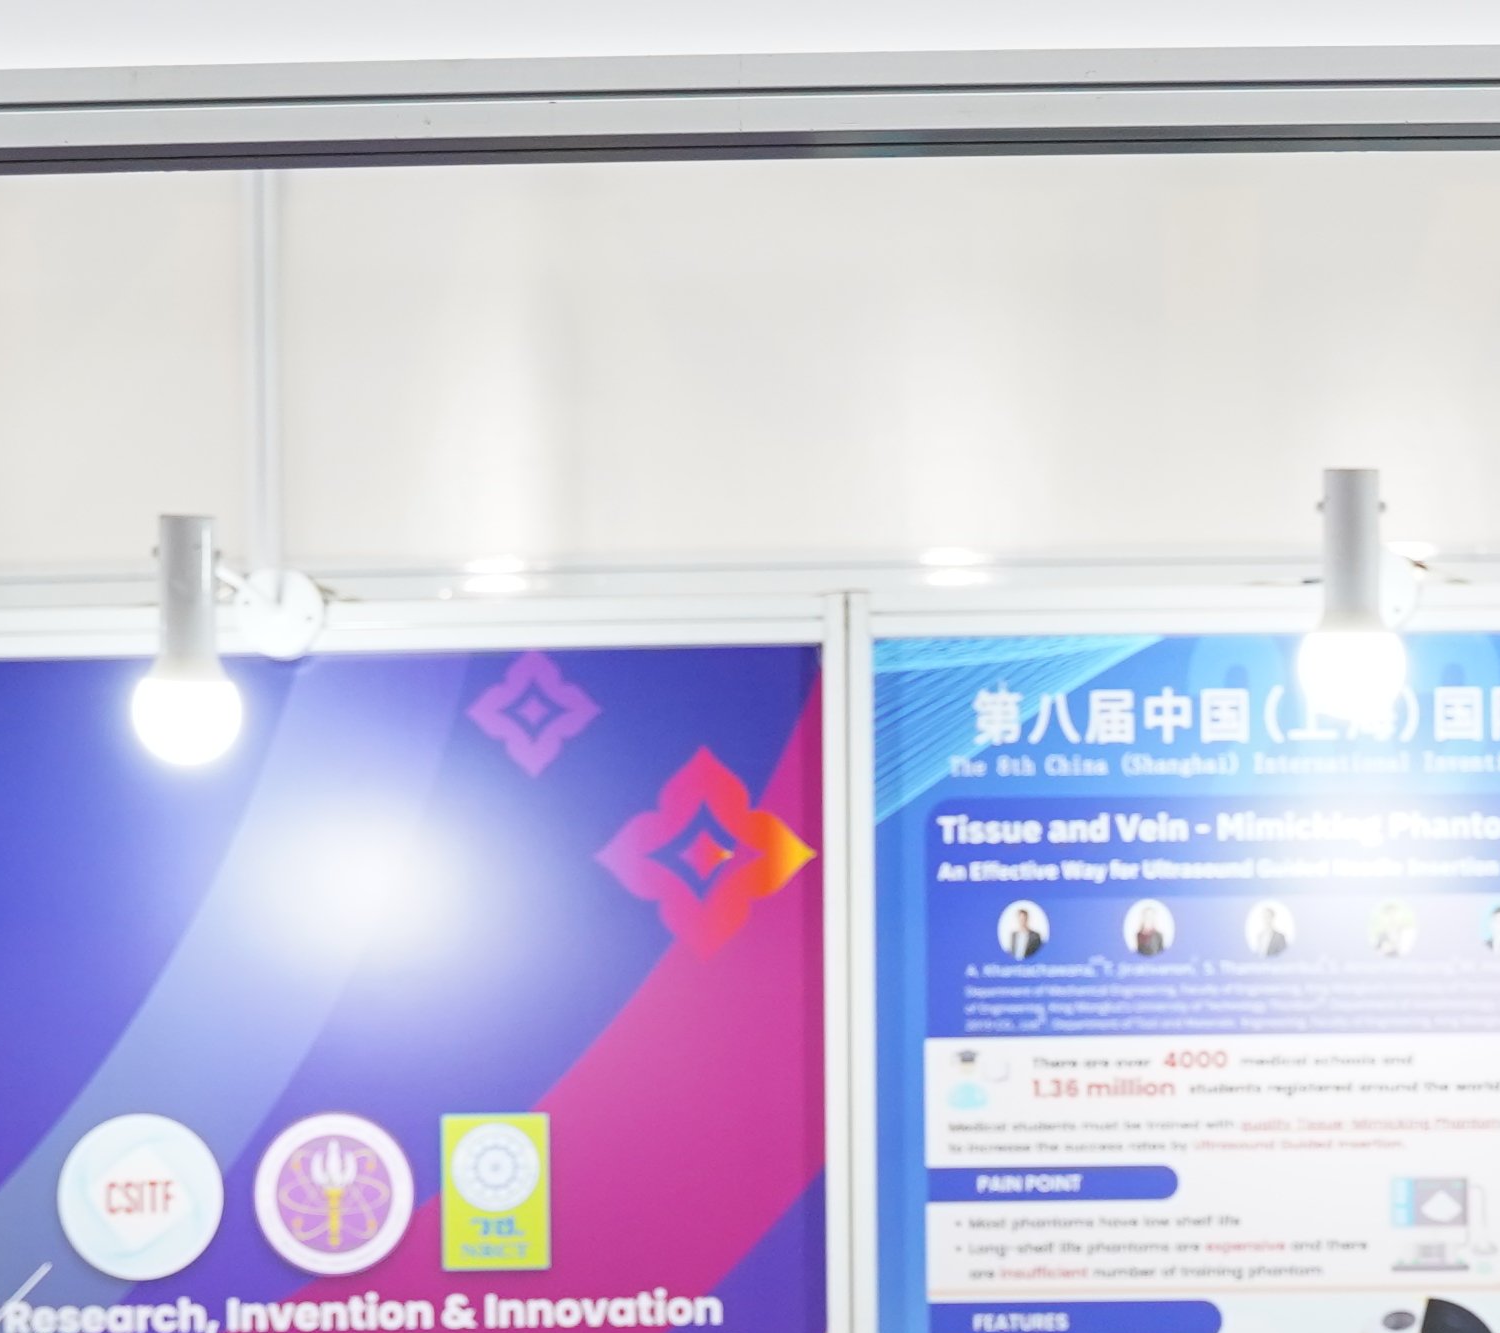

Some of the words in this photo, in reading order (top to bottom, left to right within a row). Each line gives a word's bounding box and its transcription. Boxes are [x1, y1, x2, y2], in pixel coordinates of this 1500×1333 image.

[1045, 754, 1108, 776] China
[937, 815, 1044, 846] Tissue
[1049, 814, 1109, 845] and
[1119, 814, 1189, 844] Vein
[968, 861, 1058, 882] Effective
[1062, 860, 1107, 881] Way
[1162, 1050, 1229, 1070] 4000
[1086, 1076, 1176, 1097] million
[106, 1180, 176, 1216] CSITF
[227, 1292, 433, 1333] Invention
[441, 1293, 478, 1329] &
[484, 1287, 724, 1329] Innovation
